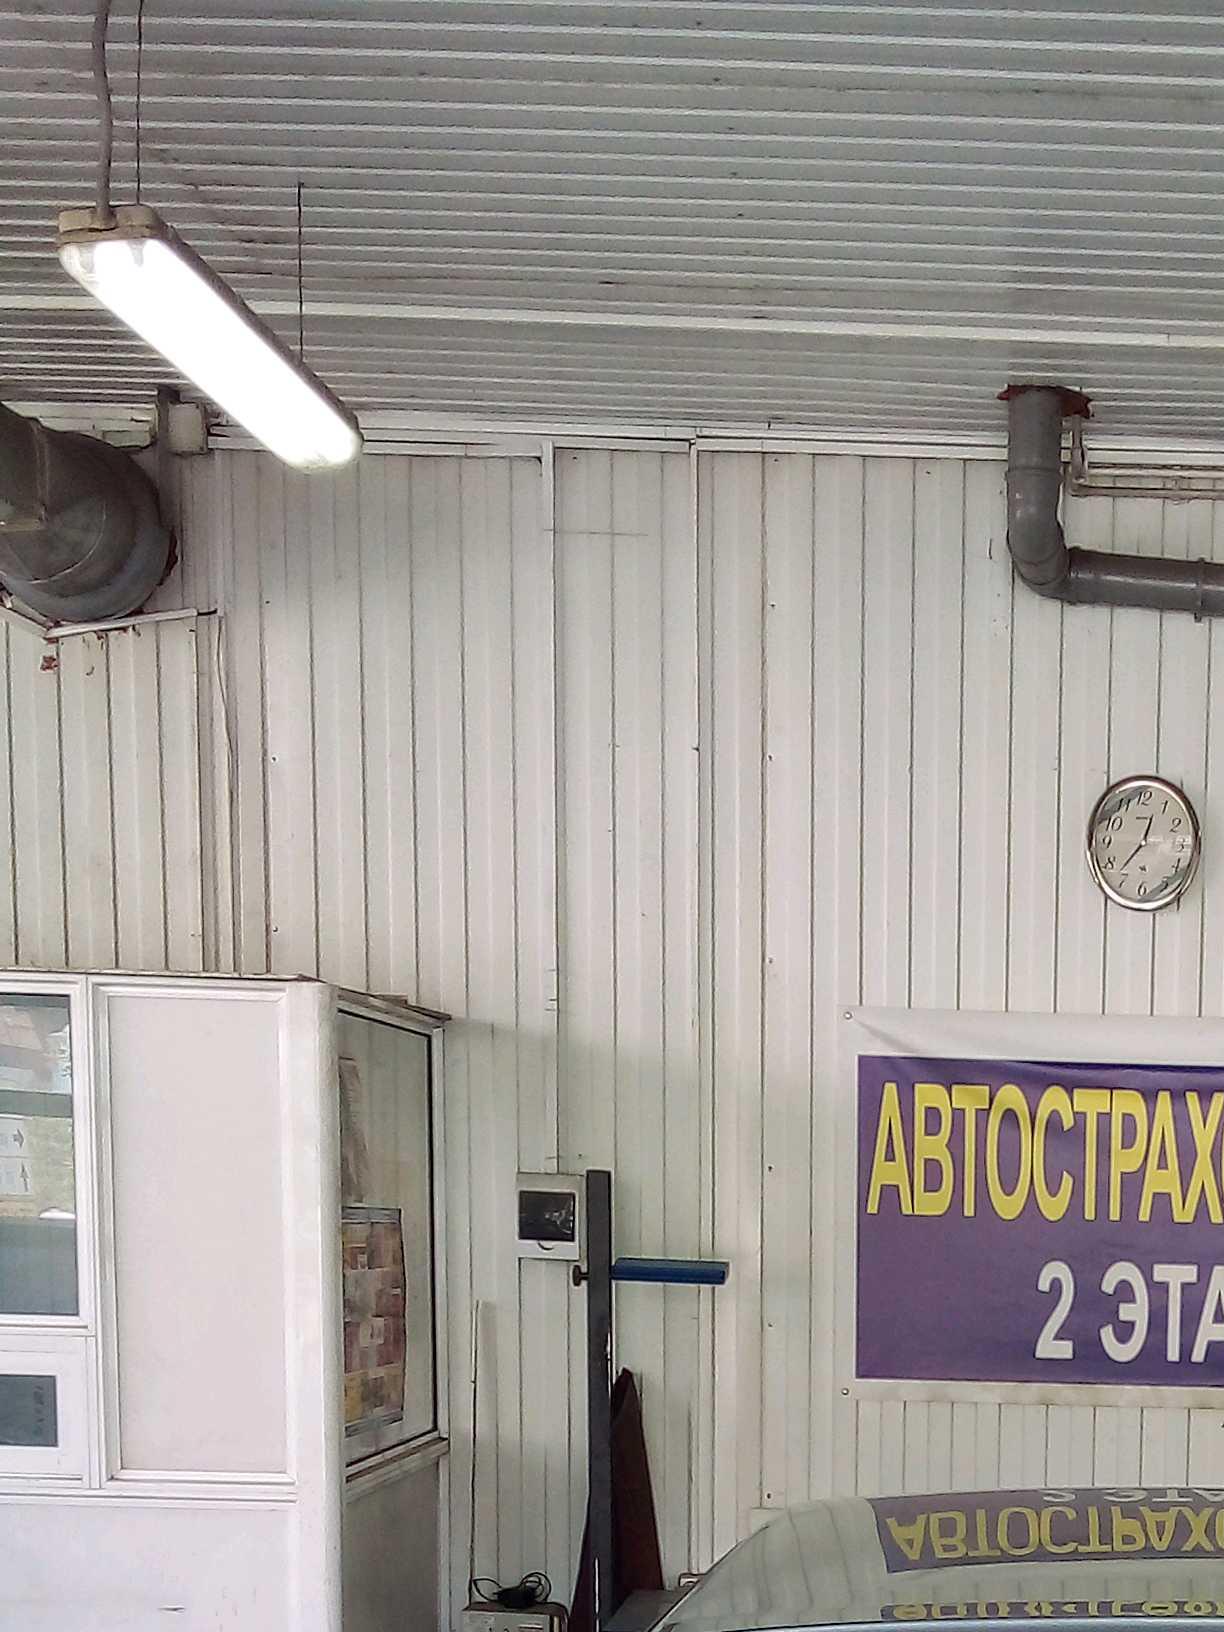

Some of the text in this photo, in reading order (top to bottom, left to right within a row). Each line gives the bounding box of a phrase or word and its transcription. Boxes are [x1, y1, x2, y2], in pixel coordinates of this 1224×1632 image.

[1137, 790, 1153, 806] 12
[1161, 800, 1169, 814] 1
[1105, 815, 1123, 831] 10
[1169, 817, 1182, 833] 2
[1102, 835, 1112, 848] 9
[1102, 856, 1116, 870] 8
[1119, 873, 1128, 888] 7
[1137, 881, 1147, 896] 6
[1034, 1260, 1075, 1360] 2
